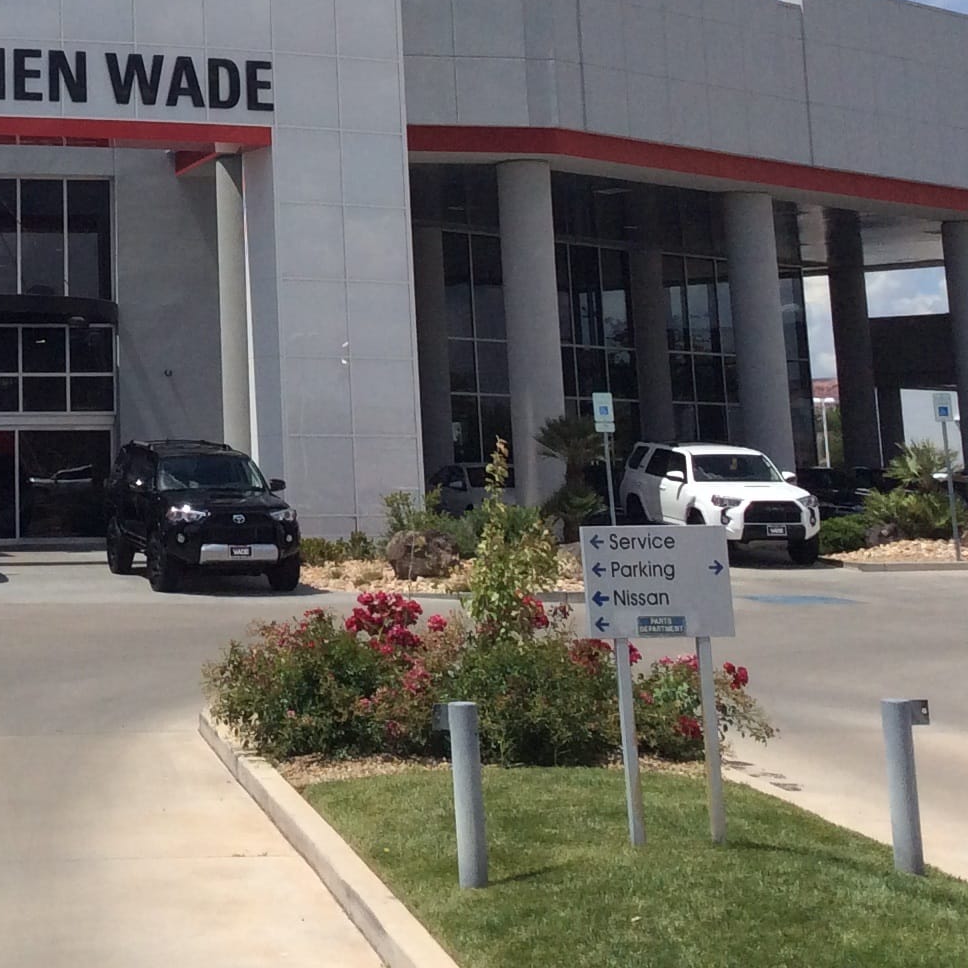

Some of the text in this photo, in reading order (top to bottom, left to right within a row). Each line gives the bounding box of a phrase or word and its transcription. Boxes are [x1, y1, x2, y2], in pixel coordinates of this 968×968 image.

[105, 52, 275, 112] WADE
[609, 533, 676, 550] Service
[611, 560, 676, 581] Parking
[613, 589, 670, 607] Nissan
